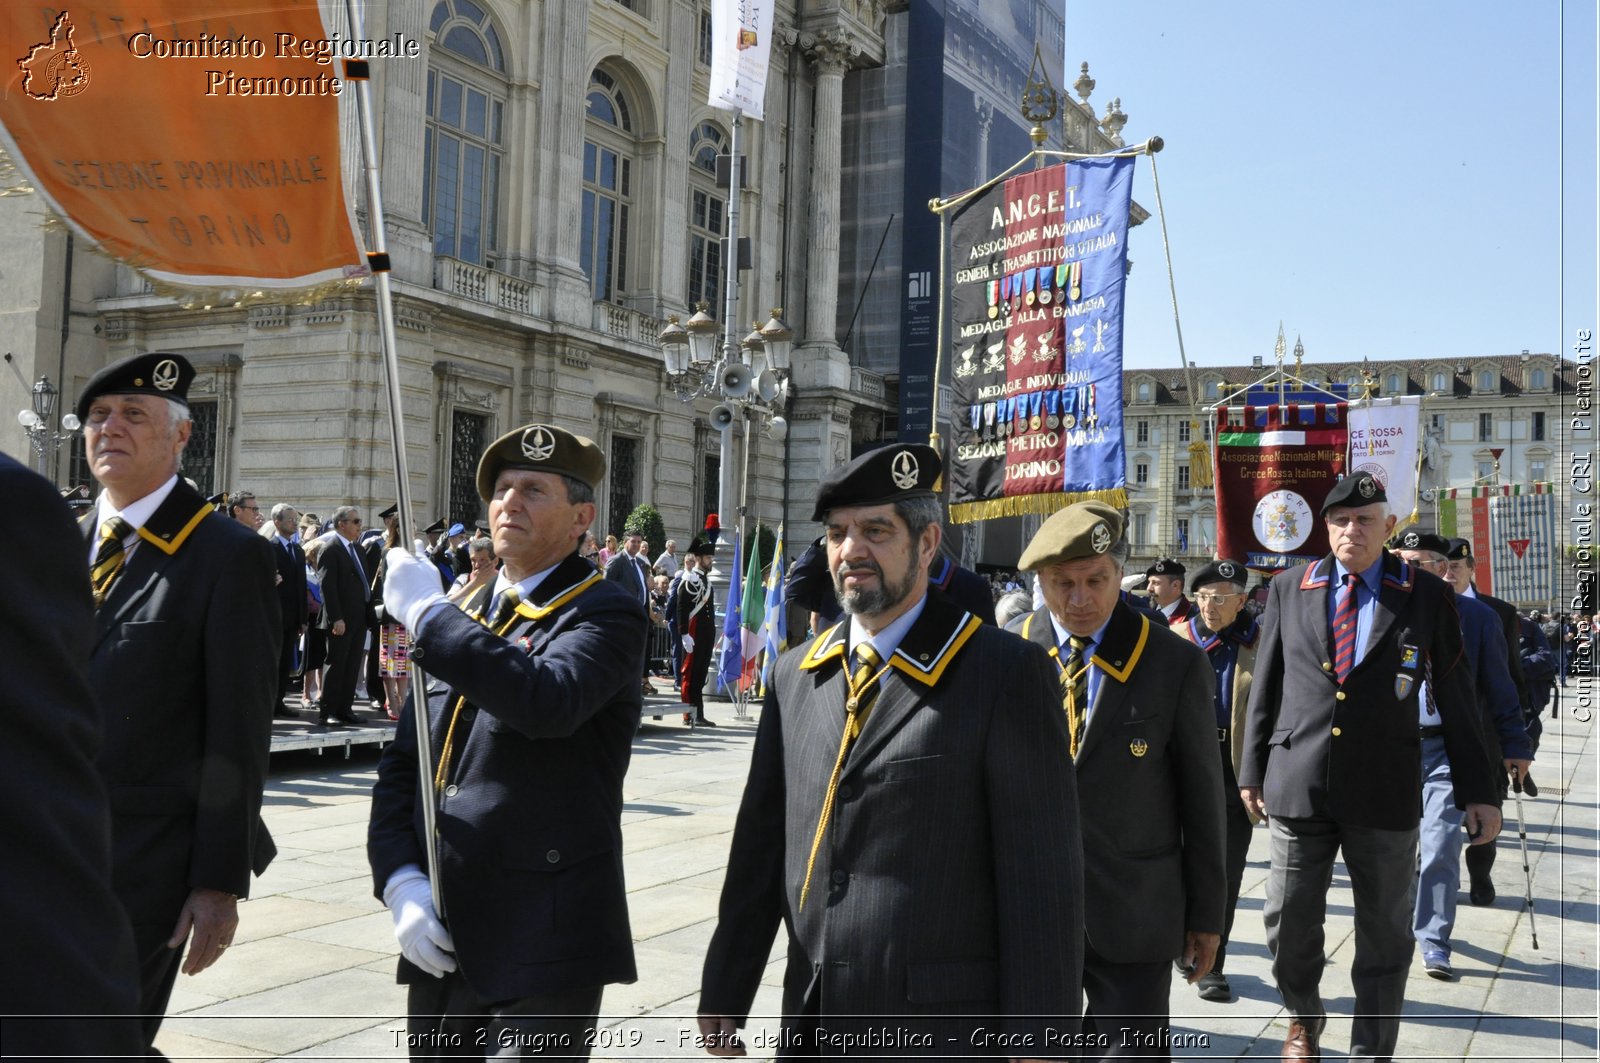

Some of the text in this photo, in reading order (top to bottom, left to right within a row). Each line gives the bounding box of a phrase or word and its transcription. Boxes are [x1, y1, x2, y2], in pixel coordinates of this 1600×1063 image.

[54, 155, 327, 190] SEZIONE PROVINCIALE
[991, 186, 1081, 230] A.N.G.E.T.
[128, 212, 292, 248] TORINO
[970, 214, 1103, 260] ASSOCIAZIONE NAZIONALE
[956, 267, 990, 285] GENIERI
[993, 263, 998, 276] E
[1002, 244, 1075, 273] TRASMETTITORI
[960, 316, 1014, 338] MEDAGLIE
[1017, 307, 1046, 324] ALLA
[978, 378, 1022, 400] MEDAGLIE
[1351, 427, 1403, 439] CE ROSSA
[957, 440, 1006, 460] SEZIONE
[1352, 440, 1389, 450] ALIANA
[1221, 451, 1274, 463] Associazione
[1274, 450, 1316, 463] Nazionale
[1004, 459, 1061, 480] TORINO
[1240, 465, 1327, 479] Croce Rossa Italiana
